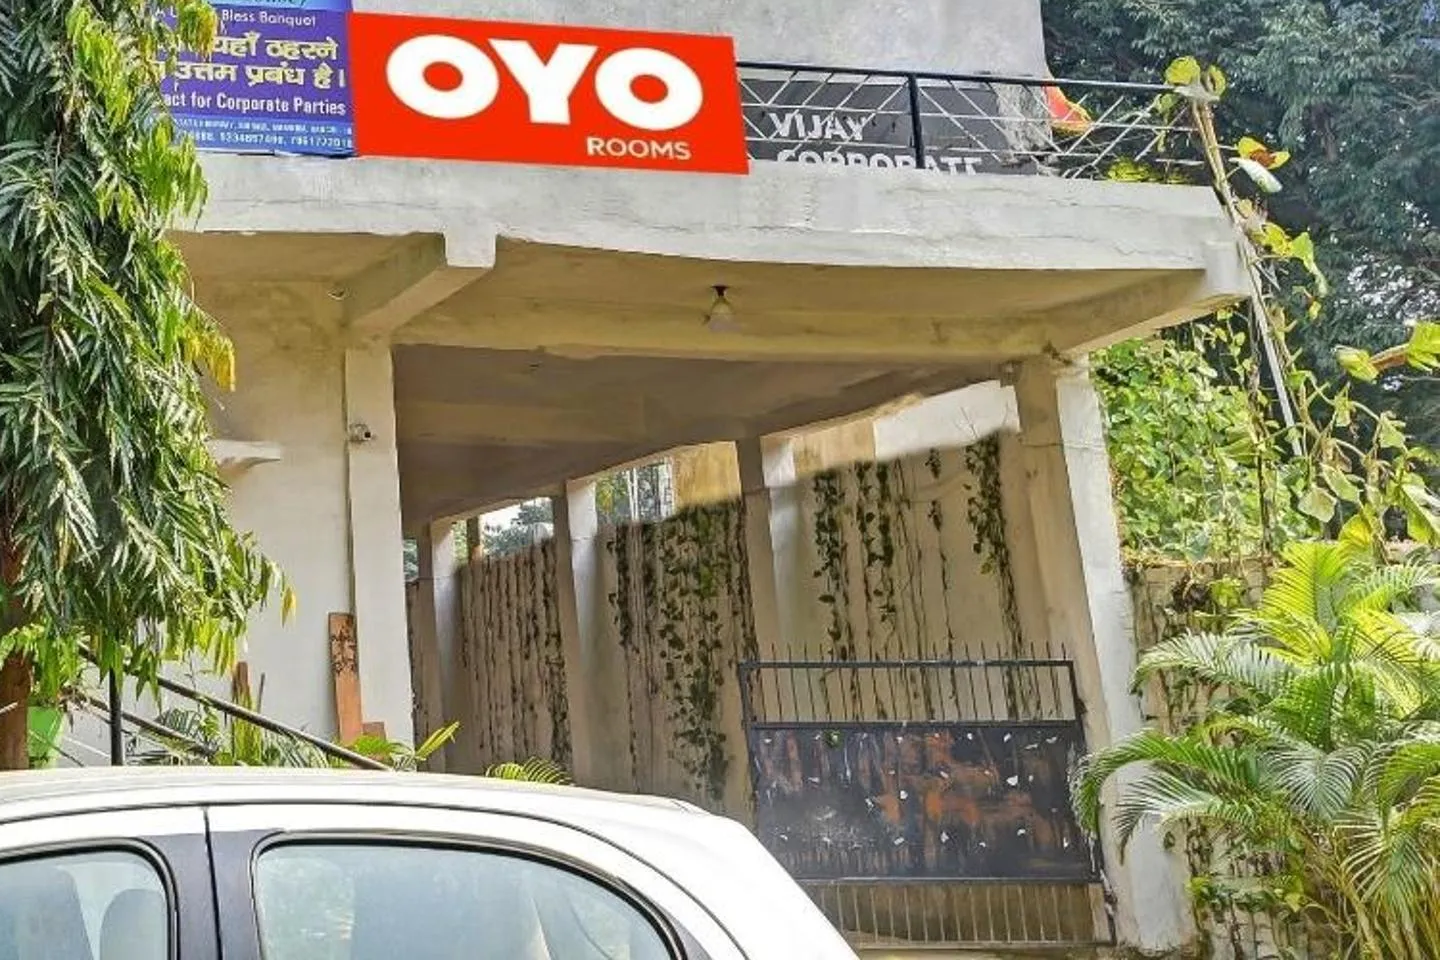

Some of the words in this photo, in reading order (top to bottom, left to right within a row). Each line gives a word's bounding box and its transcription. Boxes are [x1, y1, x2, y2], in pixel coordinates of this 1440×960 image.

[385, 34, 703, 132] OYO
[191, 92, 212, 108] for
[217, 93, 289, 114] Corporate
[294, 98, 347, 116] Parties
[768, 113, 868, 141] VIJAY
[586, 137, 691, 160] ROOMS
